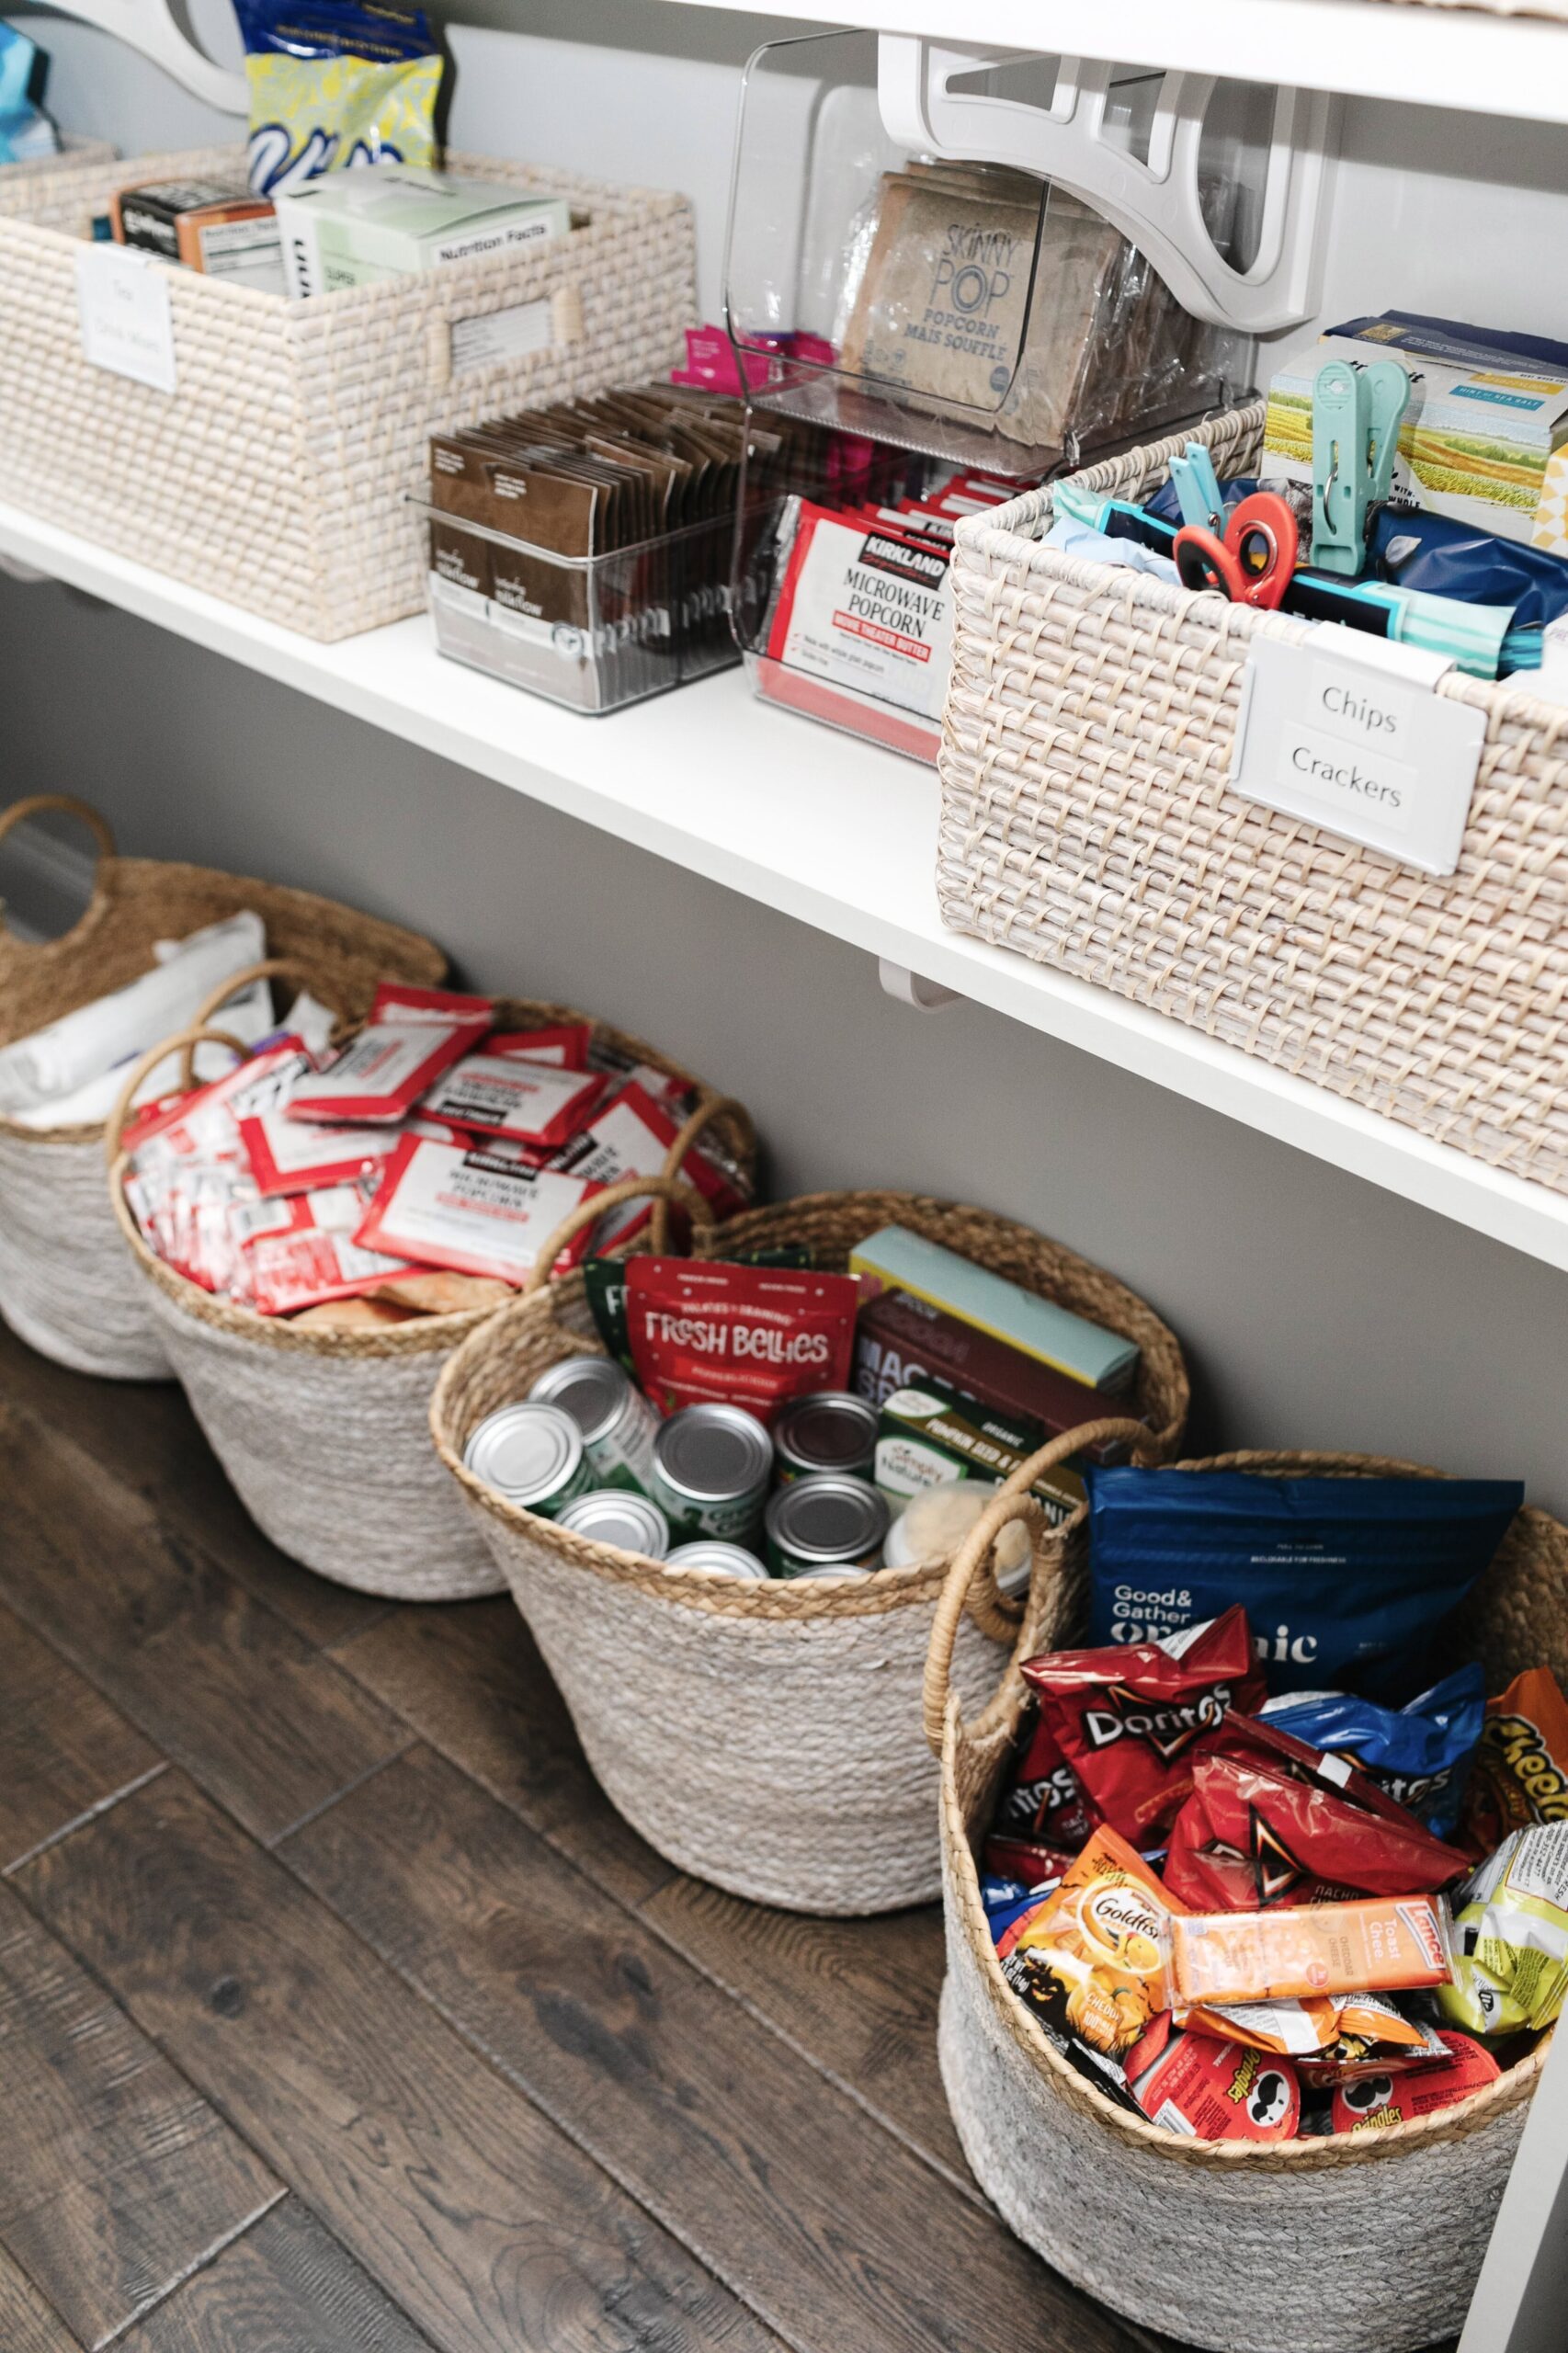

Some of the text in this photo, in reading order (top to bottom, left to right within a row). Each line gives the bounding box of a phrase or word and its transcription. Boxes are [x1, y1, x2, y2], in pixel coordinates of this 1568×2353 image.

[439, 222, 547, 261] Nutrition Facts
[942, 222, 1022, 267] SKINNY
[929, 257, 1015, 319] POP
[923, 306, 1001, 340] POPCORN
[1513, 396, 1540, 408] SALT
[866, 537, 947, 577] KIRKLAND
[843, 567, 946, 621] MICROWAVE
[847, 594, 927, 639] POPCORN
[1322, 686, 1397, 733] Chips
[1292, 746, 1403, 809] Crackers
[925, 1418, 974, 1450] PUMPKIN
[971, 1437, 1003, 1465] SEED
[1112, 1601, 1192, 1624] Gather
[1085, 1683, 1232, 1746] Doritos
[1339, 1936, 1353, 1976] CHEDDAR
[1383, 1918, 1401, 1961] Toast
[1405, 1904, 1445, 1966] Lance
[1227, 2048, 1262, 2105] Pringles
